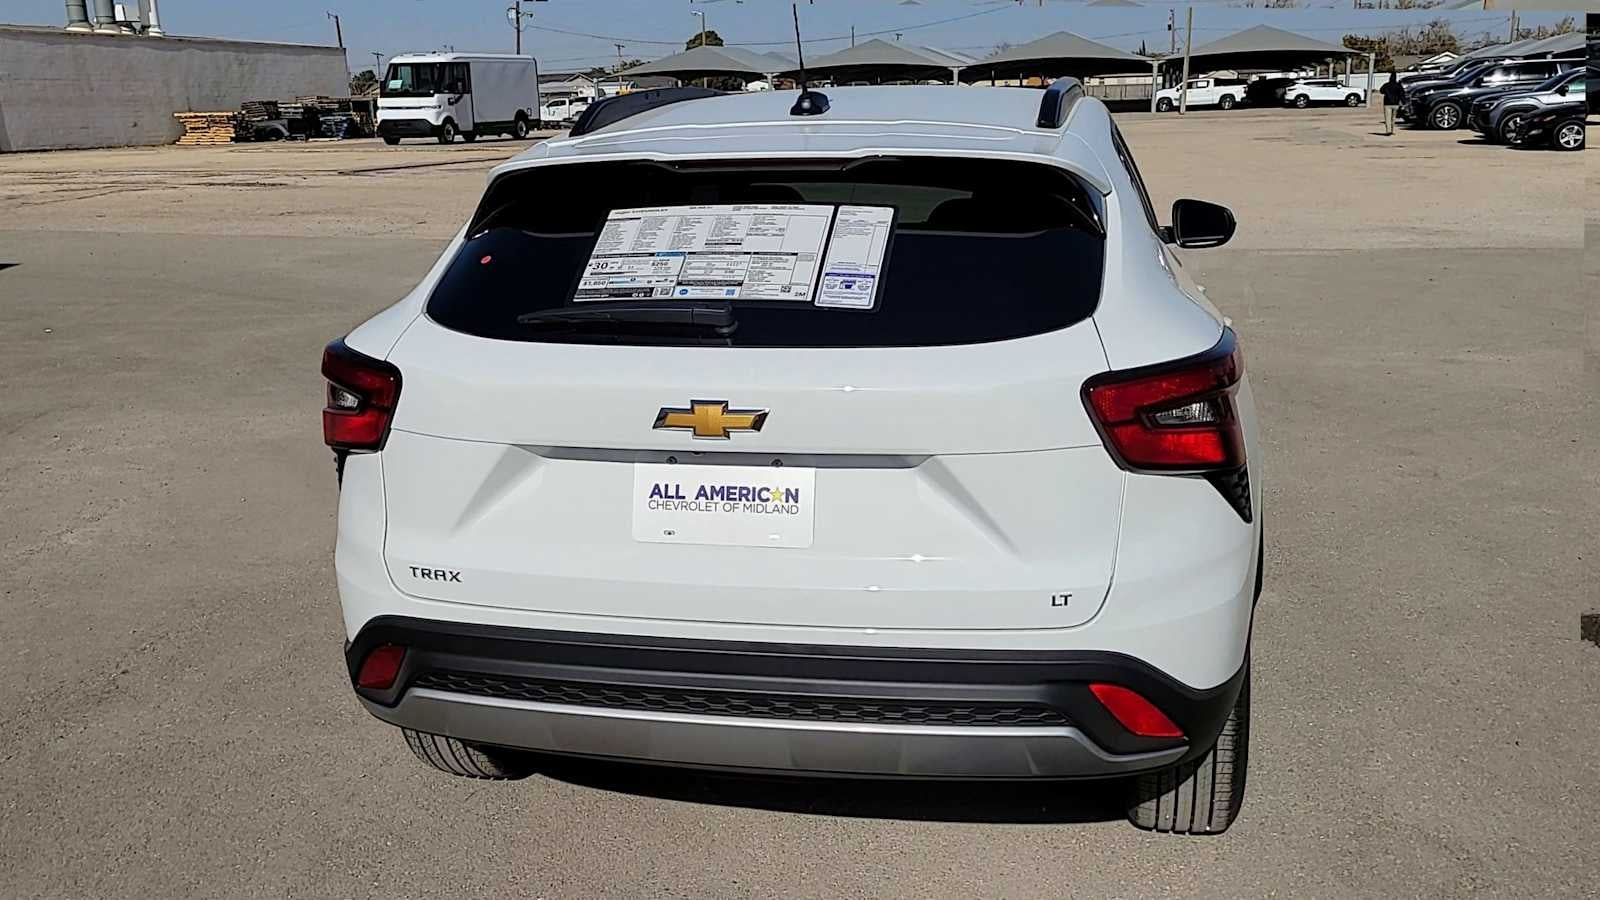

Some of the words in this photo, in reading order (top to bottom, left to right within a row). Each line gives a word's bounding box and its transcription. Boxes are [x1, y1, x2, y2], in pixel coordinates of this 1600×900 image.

[592, 262, 609, 270] 30
[649, 483, 686, 500] ALL
[695, 485, 799, 503] AMERICN
[648, 500, 719, 512] CHEVROLET
[722, 502, 740, 513] OF
[743, 503, 799, 515] MIDLAND
[409, 566, 462, 582] TRAX
[1051, 594, 1072, 606] LT
